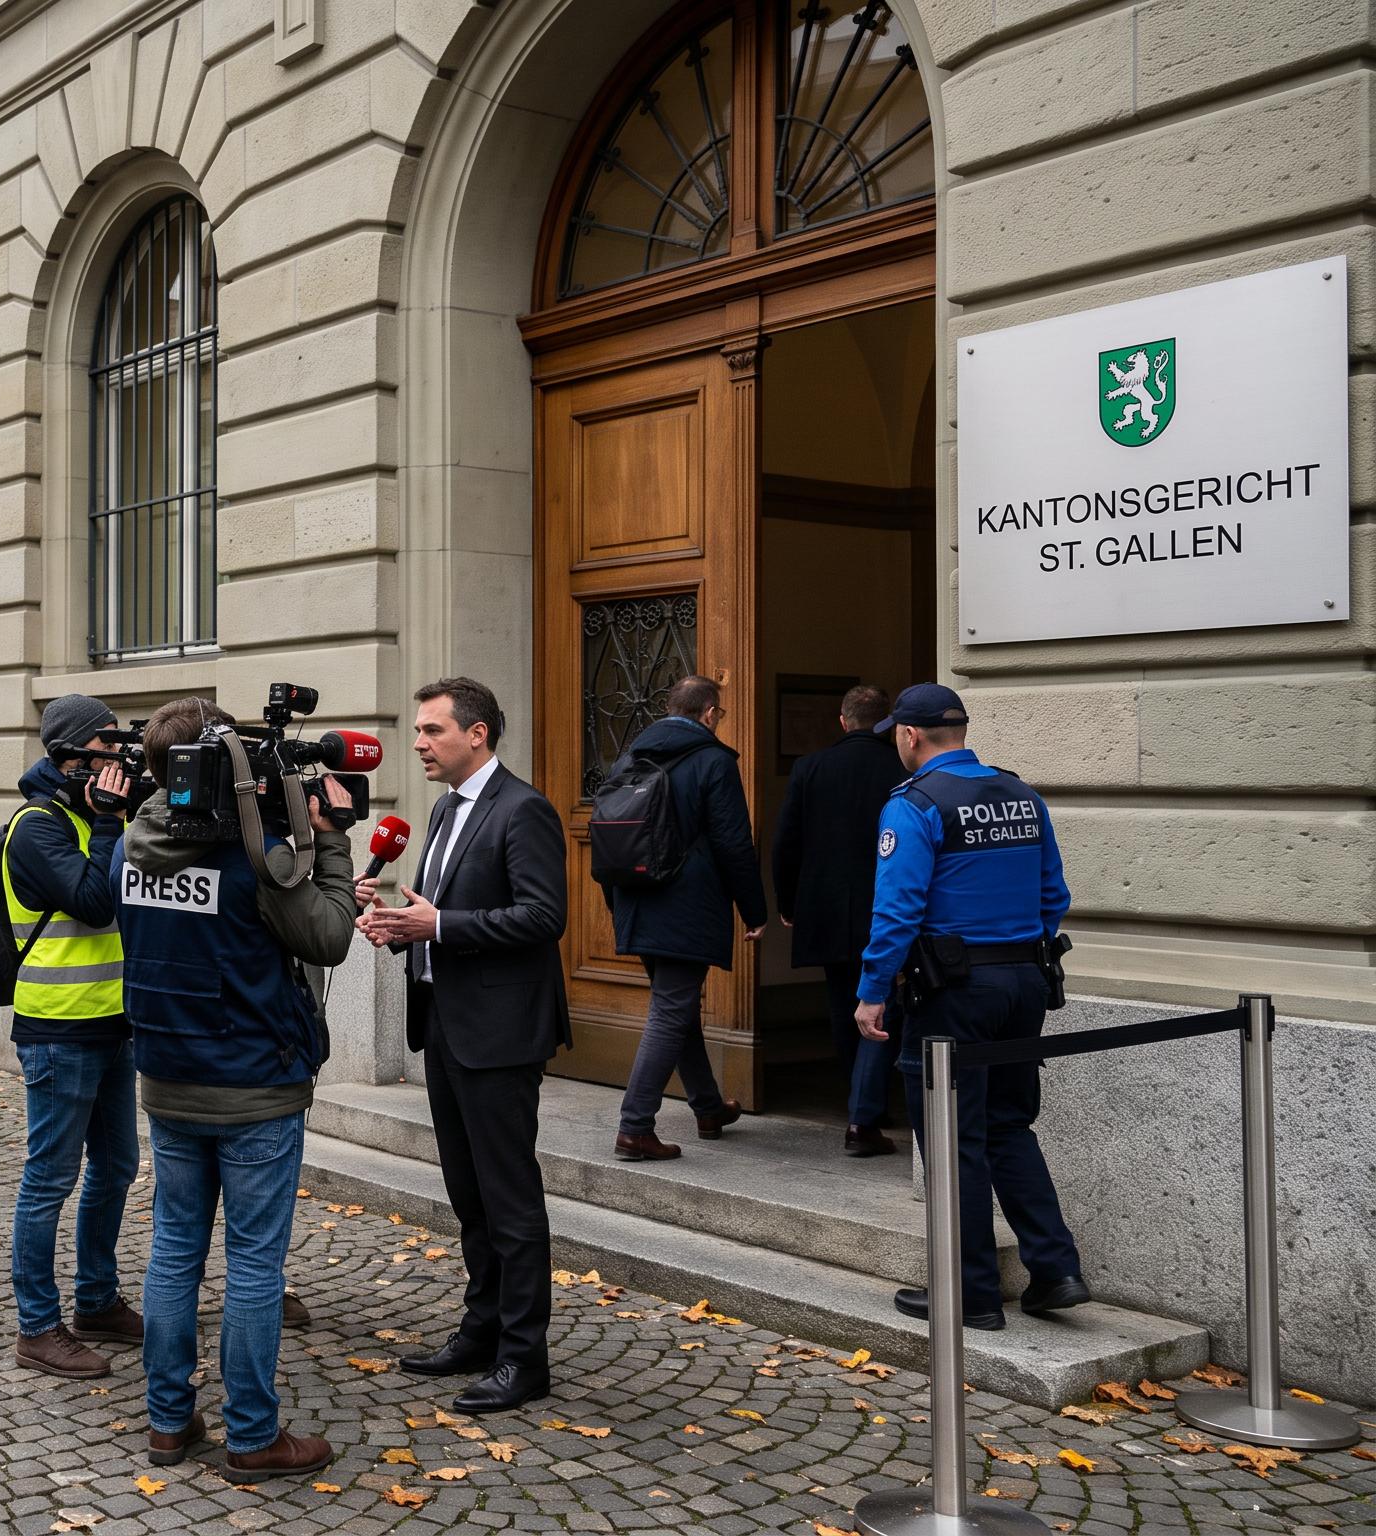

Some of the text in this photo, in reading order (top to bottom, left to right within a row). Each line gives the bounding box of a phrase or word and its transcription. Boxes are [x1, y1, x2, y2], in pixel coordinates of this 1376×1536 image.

[979, 464, 1320, 534] KANTONSGERICHT
[1040, 523, 1241, 572] ST. GALLEN
[958, 801, 1037, 825] POLIZEI
[964, 825, 1039, 844] ST. GALLEN
[126, 870, 211, 906] PRESS
